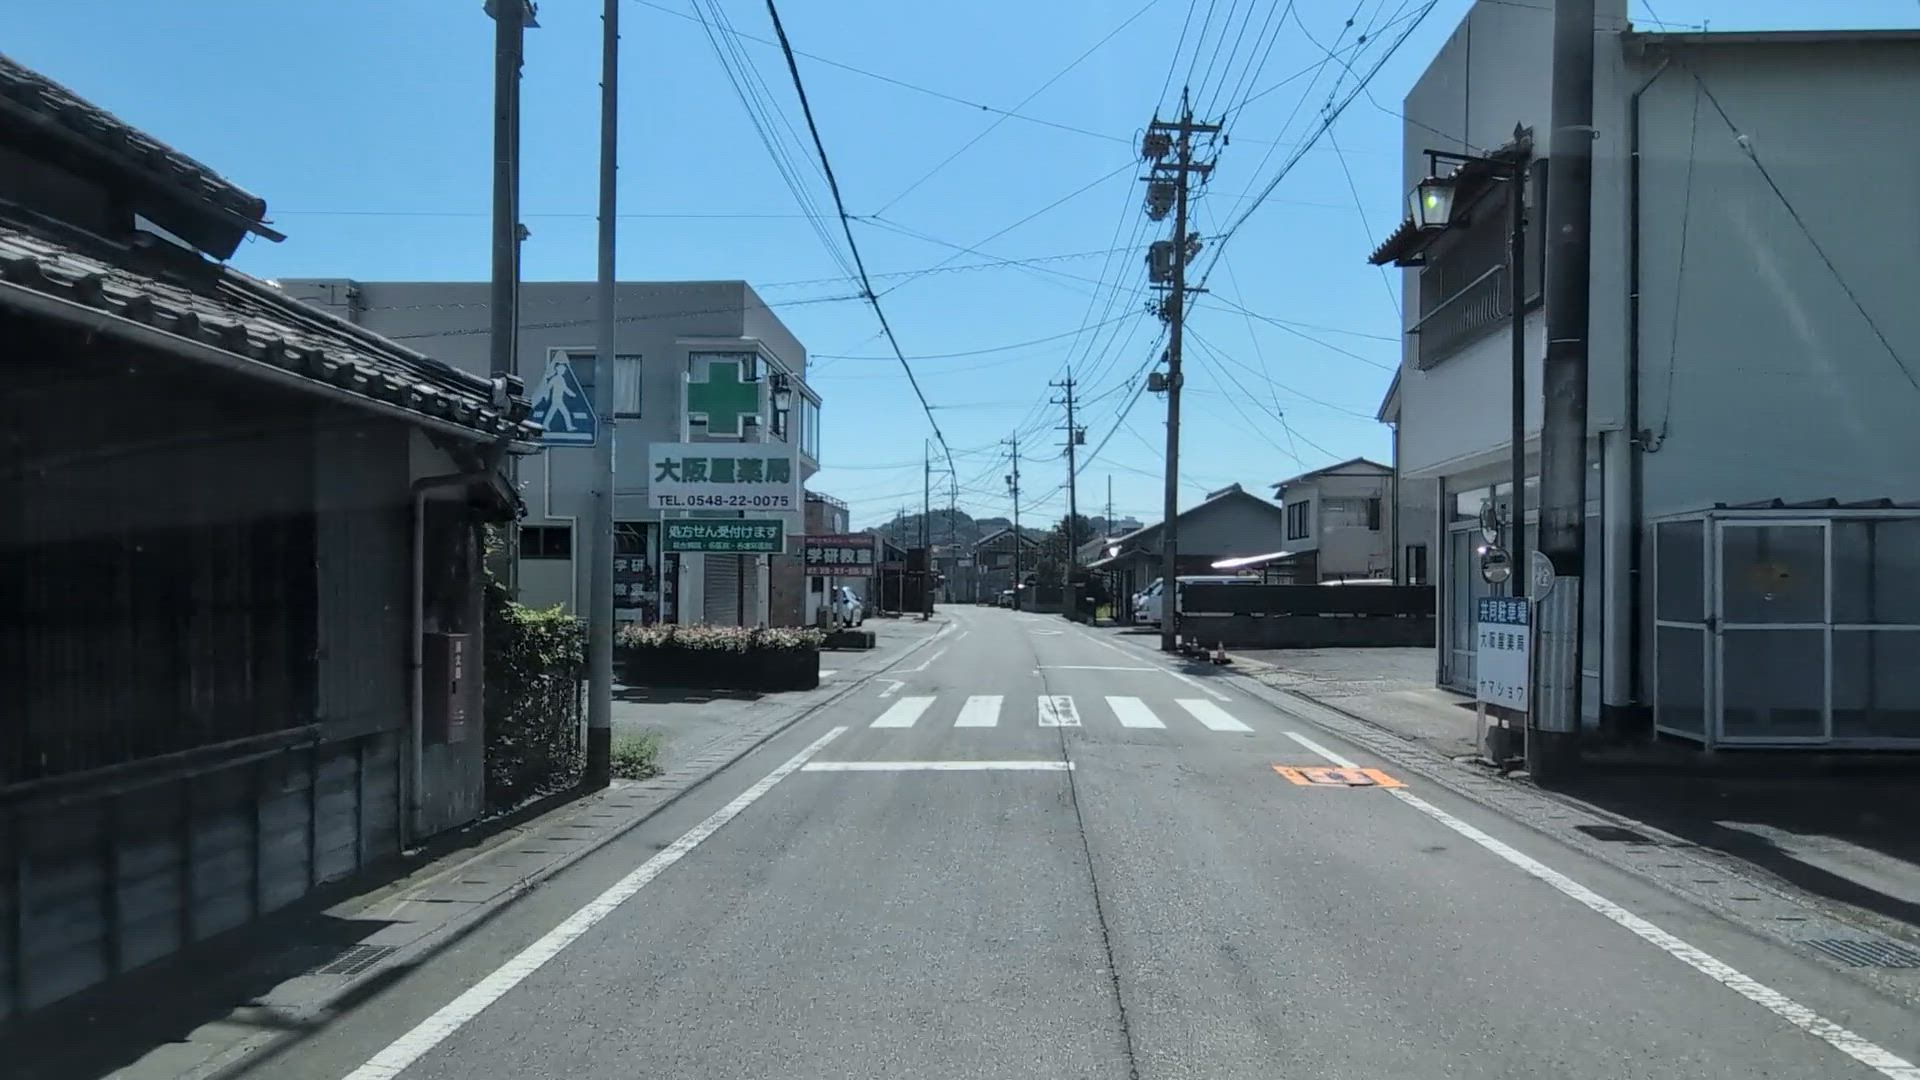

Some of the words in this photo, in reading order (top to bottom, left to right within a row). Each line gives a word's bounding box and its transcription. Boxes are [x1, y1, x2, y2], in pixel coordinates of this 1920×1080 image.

[668, 525, 777, 540] 処方せん受付けます
[806, 547, 872, 564] 学研教室
[1480, 600, 1527, 624] 共同駐車場
